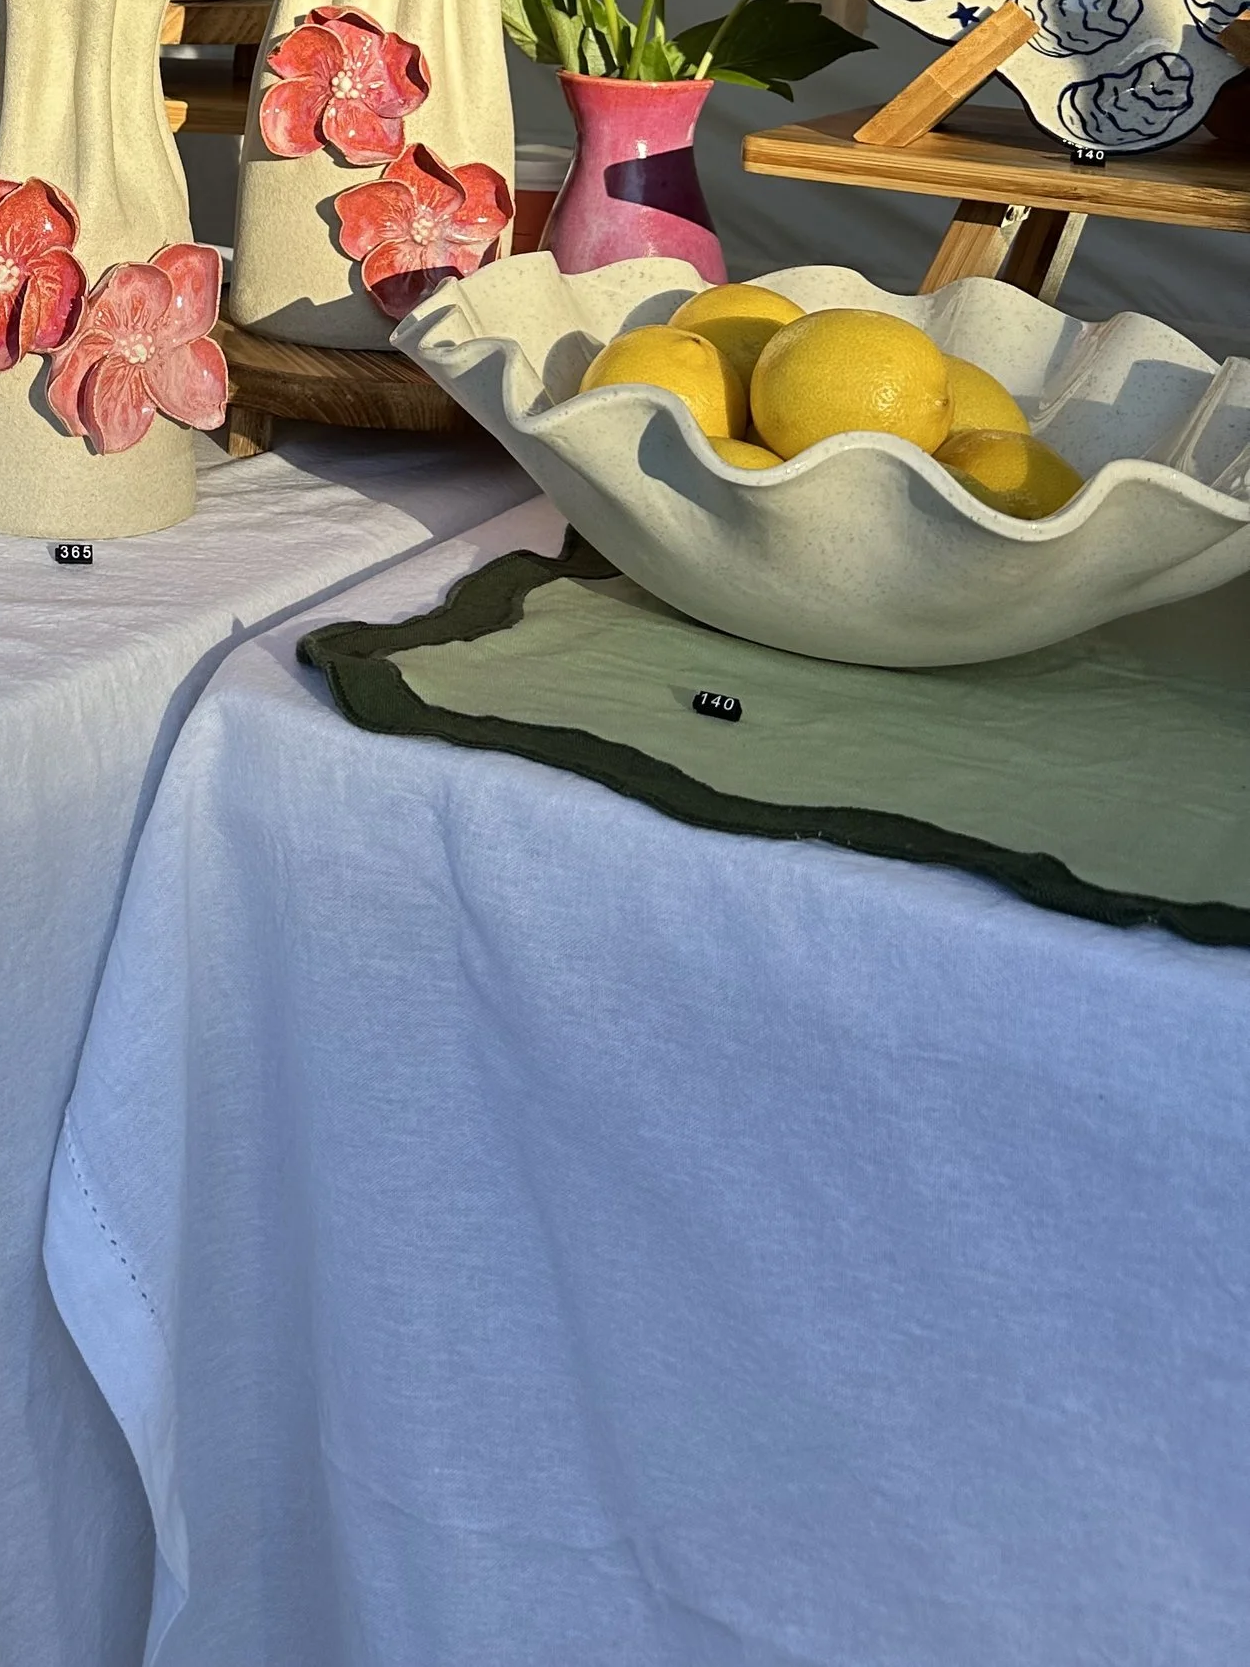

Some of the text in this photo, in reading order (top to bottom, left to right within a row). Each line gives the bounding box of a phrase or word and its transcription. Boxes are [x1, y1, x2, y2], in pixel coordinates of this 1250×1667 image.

[1076, 149, 1105, 160] 140
[60, 545, 92, 559] 365
[701, 692, 735, 711] 140
